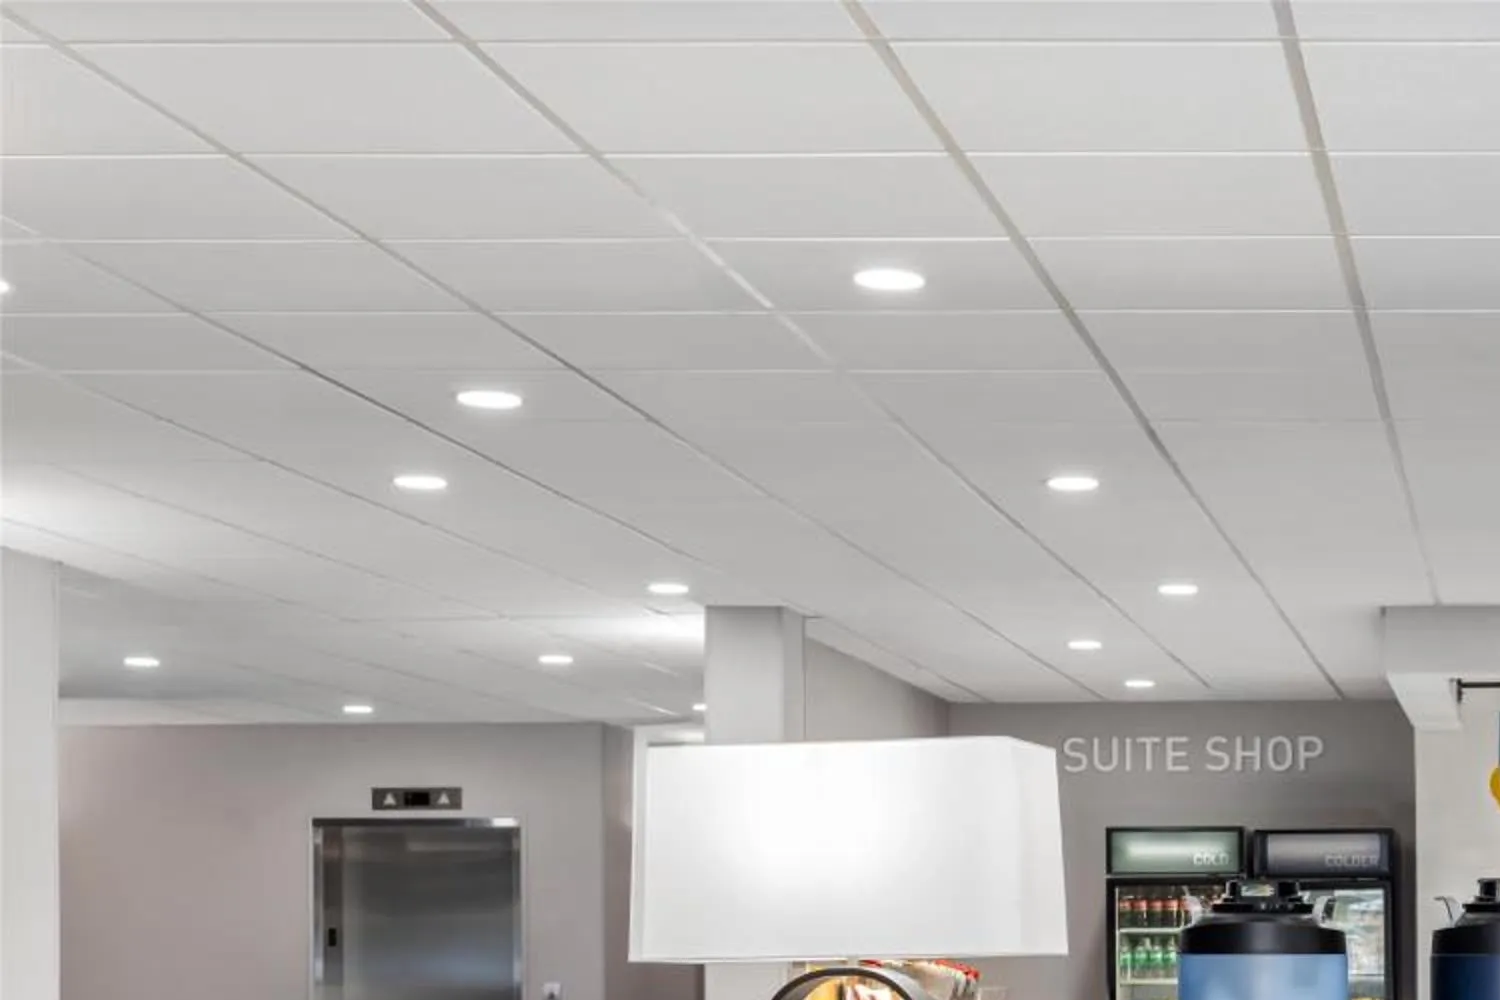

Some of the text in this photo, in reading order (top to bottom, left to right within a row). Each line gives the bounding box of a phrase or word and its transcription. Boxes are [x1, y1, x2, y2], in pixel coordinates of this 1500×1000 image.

[1063, 736, 1324, 772] SUITE SHOP
[1193, 853, 1229, 866] COLD
[1324, 854, 1379, 867] COLDER
